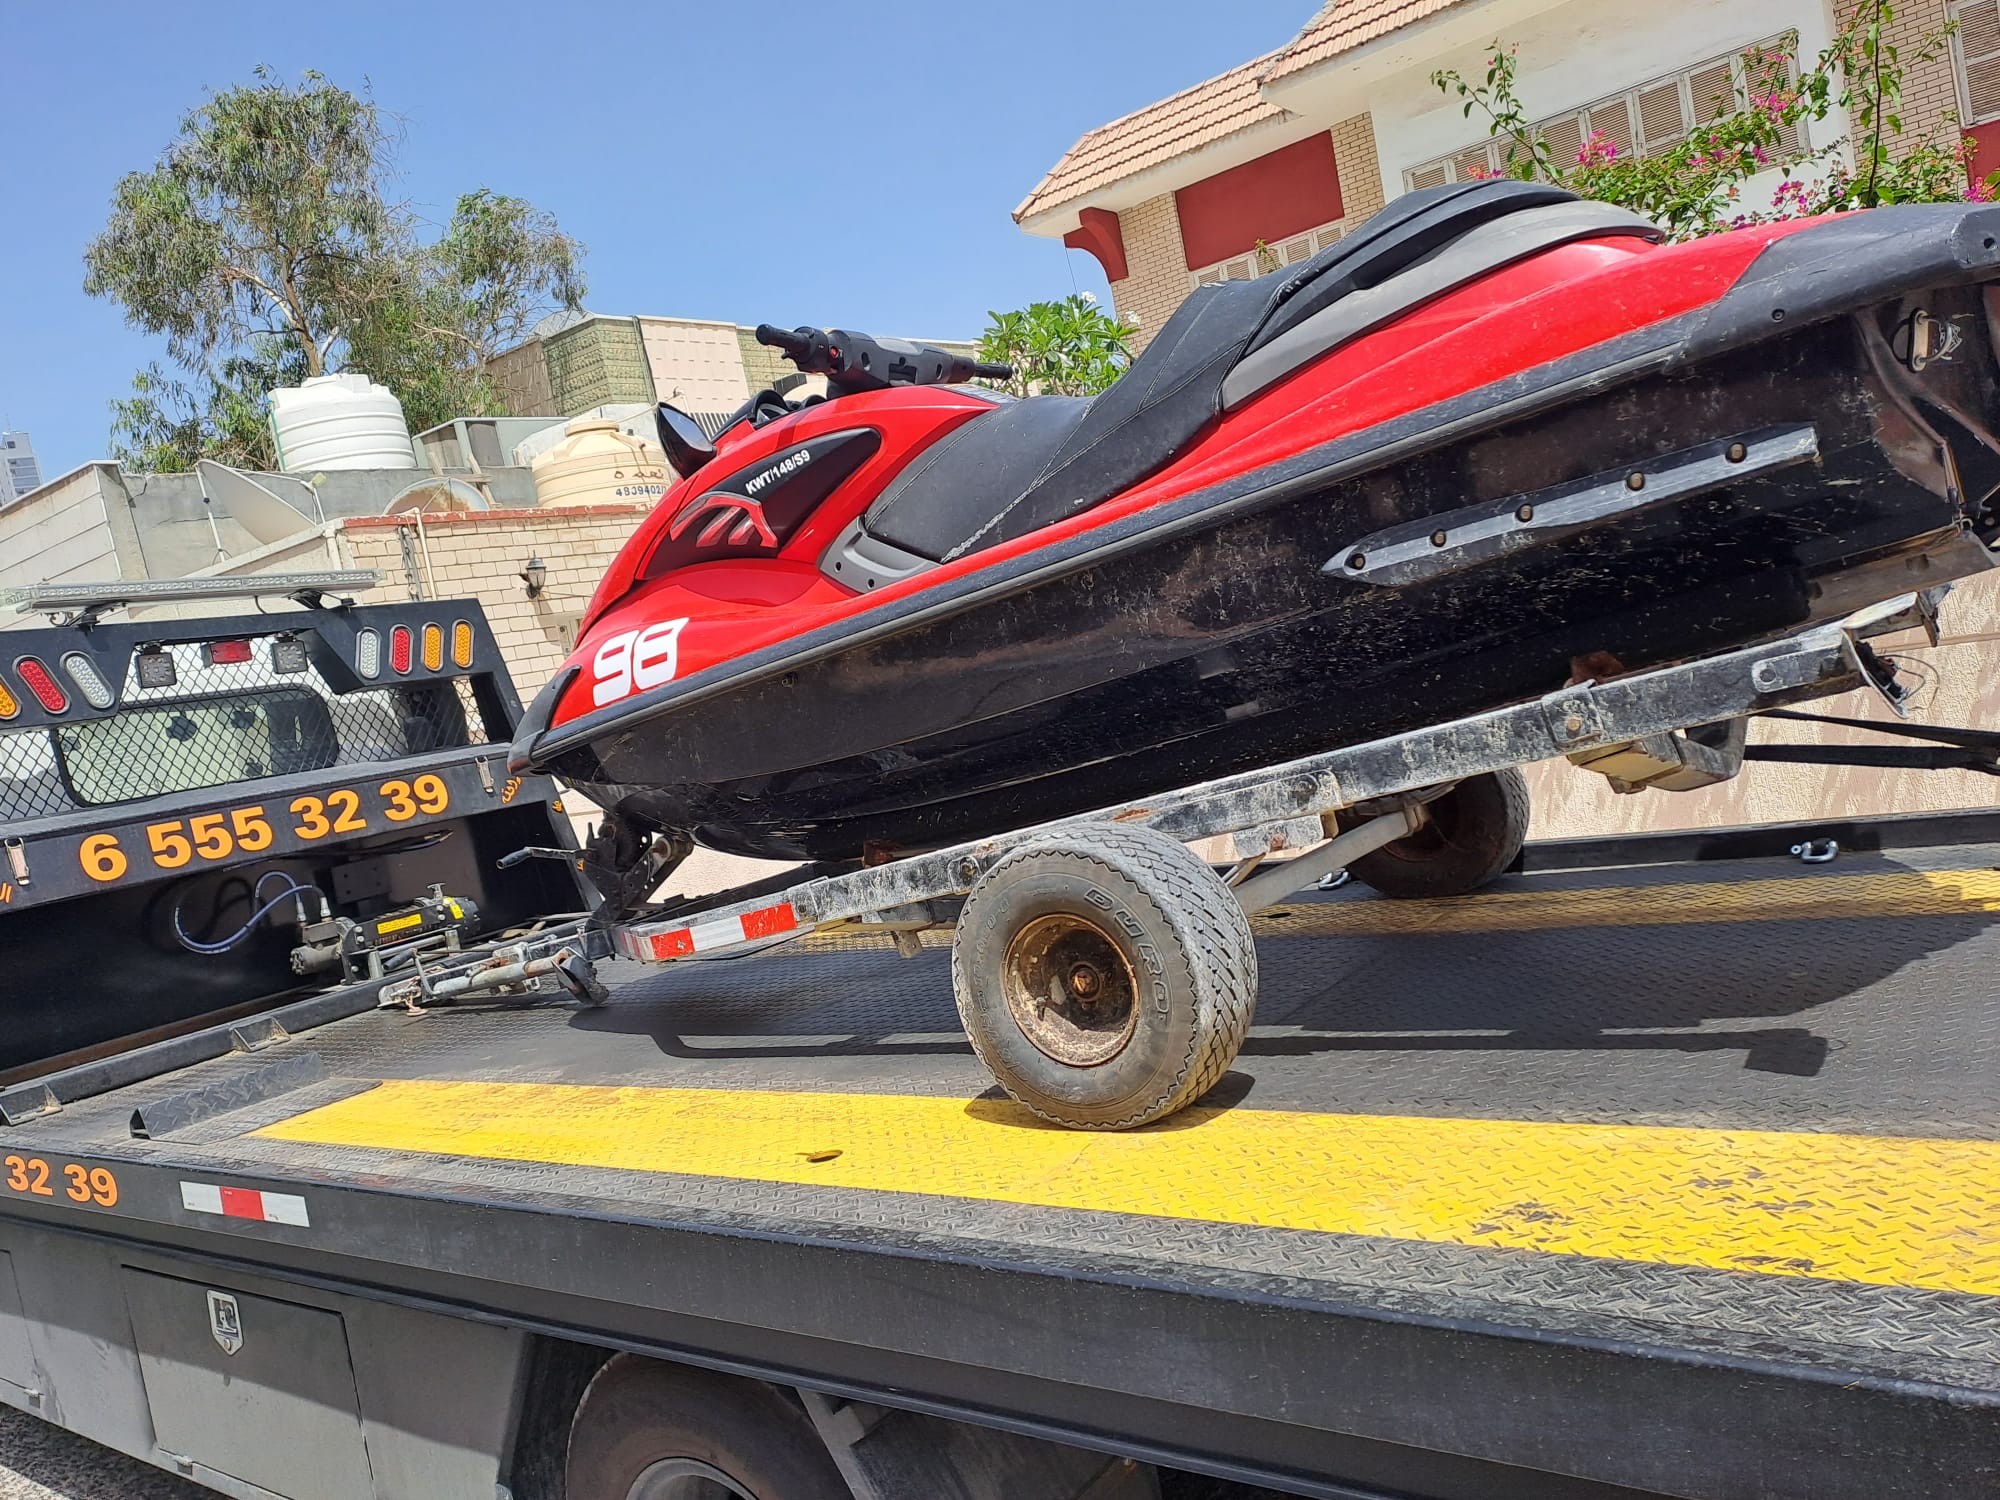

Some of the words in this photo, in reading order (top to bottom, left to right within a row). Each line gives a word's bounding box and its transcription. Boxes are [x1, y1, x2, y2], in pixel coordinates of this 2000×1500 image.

[745, 449, 810, 495] KWT/148/S9
[593, 617, 689, 707] 98
[79, 833, 128, 882] 6
[146, 806, 273, 869] 555
[289, 789, 367, 840] 32
[379, 774, 450, 822] 39
[1084, 887, 1170, 1013] DURO
[4, 1155, 54, 1197] 32
[63, 1163, 118, 1208] 39
